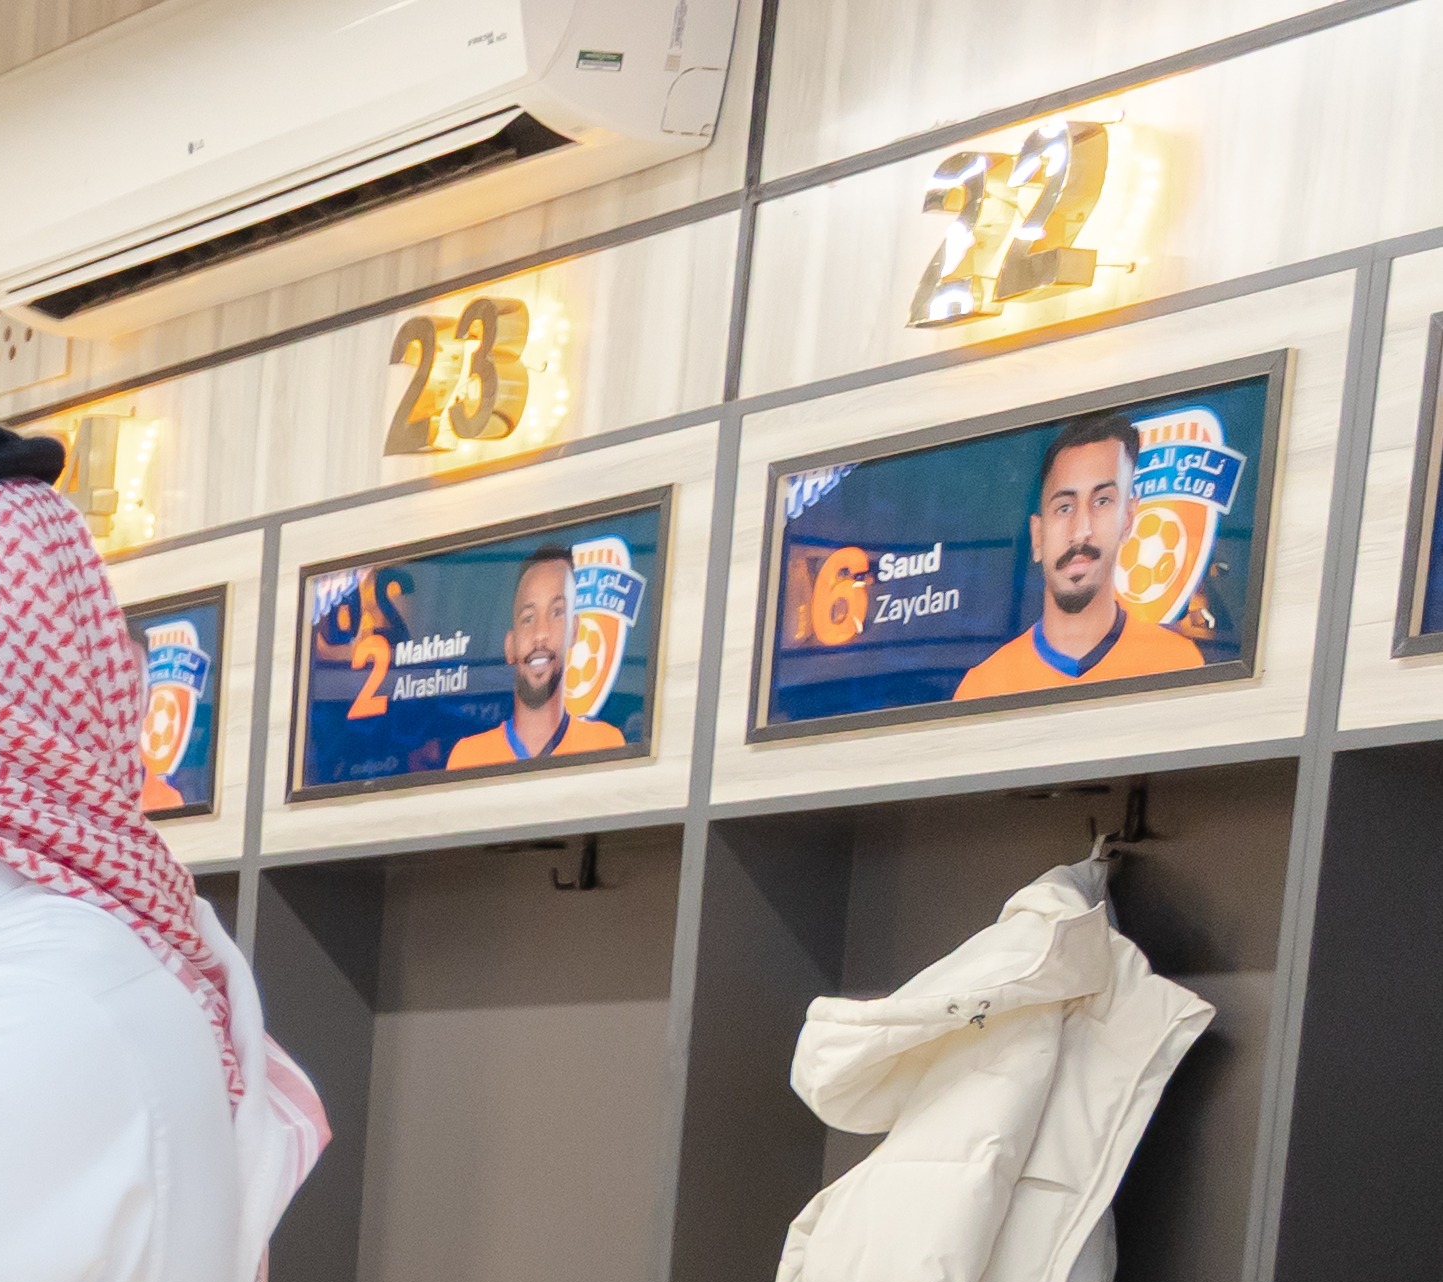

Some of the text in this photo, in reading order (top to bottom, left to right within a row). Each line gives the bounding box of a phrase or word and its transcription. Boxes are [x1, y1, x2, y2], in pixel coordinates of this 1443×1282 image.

[905, 119, 1097, 328] 22
[383, 297, 517, 456] 23
[1173, 476, 1216, 498] CLUB
[811, 542, 943, 645] 6 Saud
[873, 585, 960, 625] Zaydan
[347, 630, 471, 720] 2 Makhair
[392, 665, 469, 701] Alrashidi
